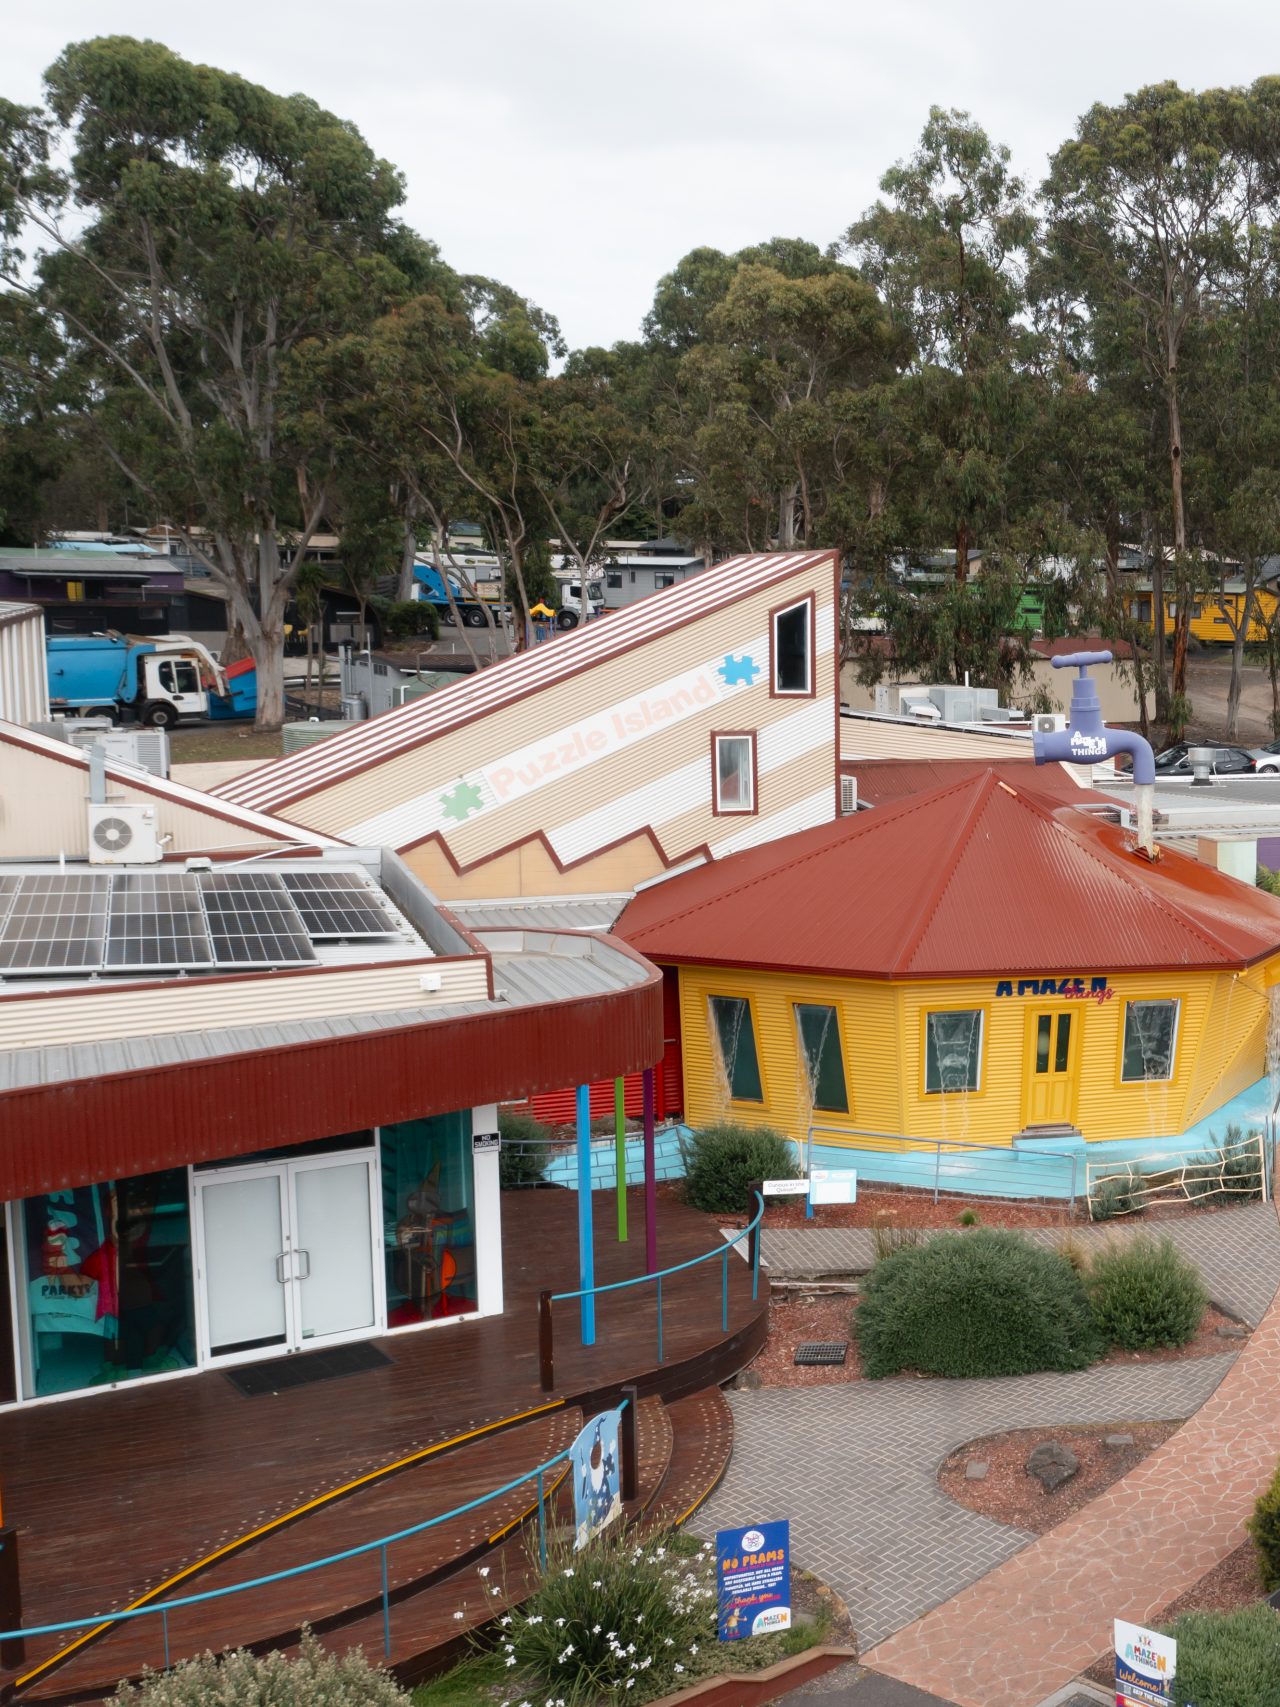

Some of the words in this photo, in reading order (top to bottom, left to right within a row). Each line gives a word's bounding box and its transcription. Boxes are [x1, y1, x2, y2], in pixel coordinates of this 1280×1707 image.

[488, 729, 608, 798] Puzzle
[610, 674, 717, 739] Island
[1071, 748, 1107, 756] THINGS
[1063, 985, 1115, 1004] things
[474, 1139, 499, 1148] SMOKING
[723, 1559, 738, 1570] NO
[743, 1549, 784, 1566] PRAMS
[1135, 1654, 1157, 1668] THINGS
[1120, 1669, 1161, 1694] Welcome!
